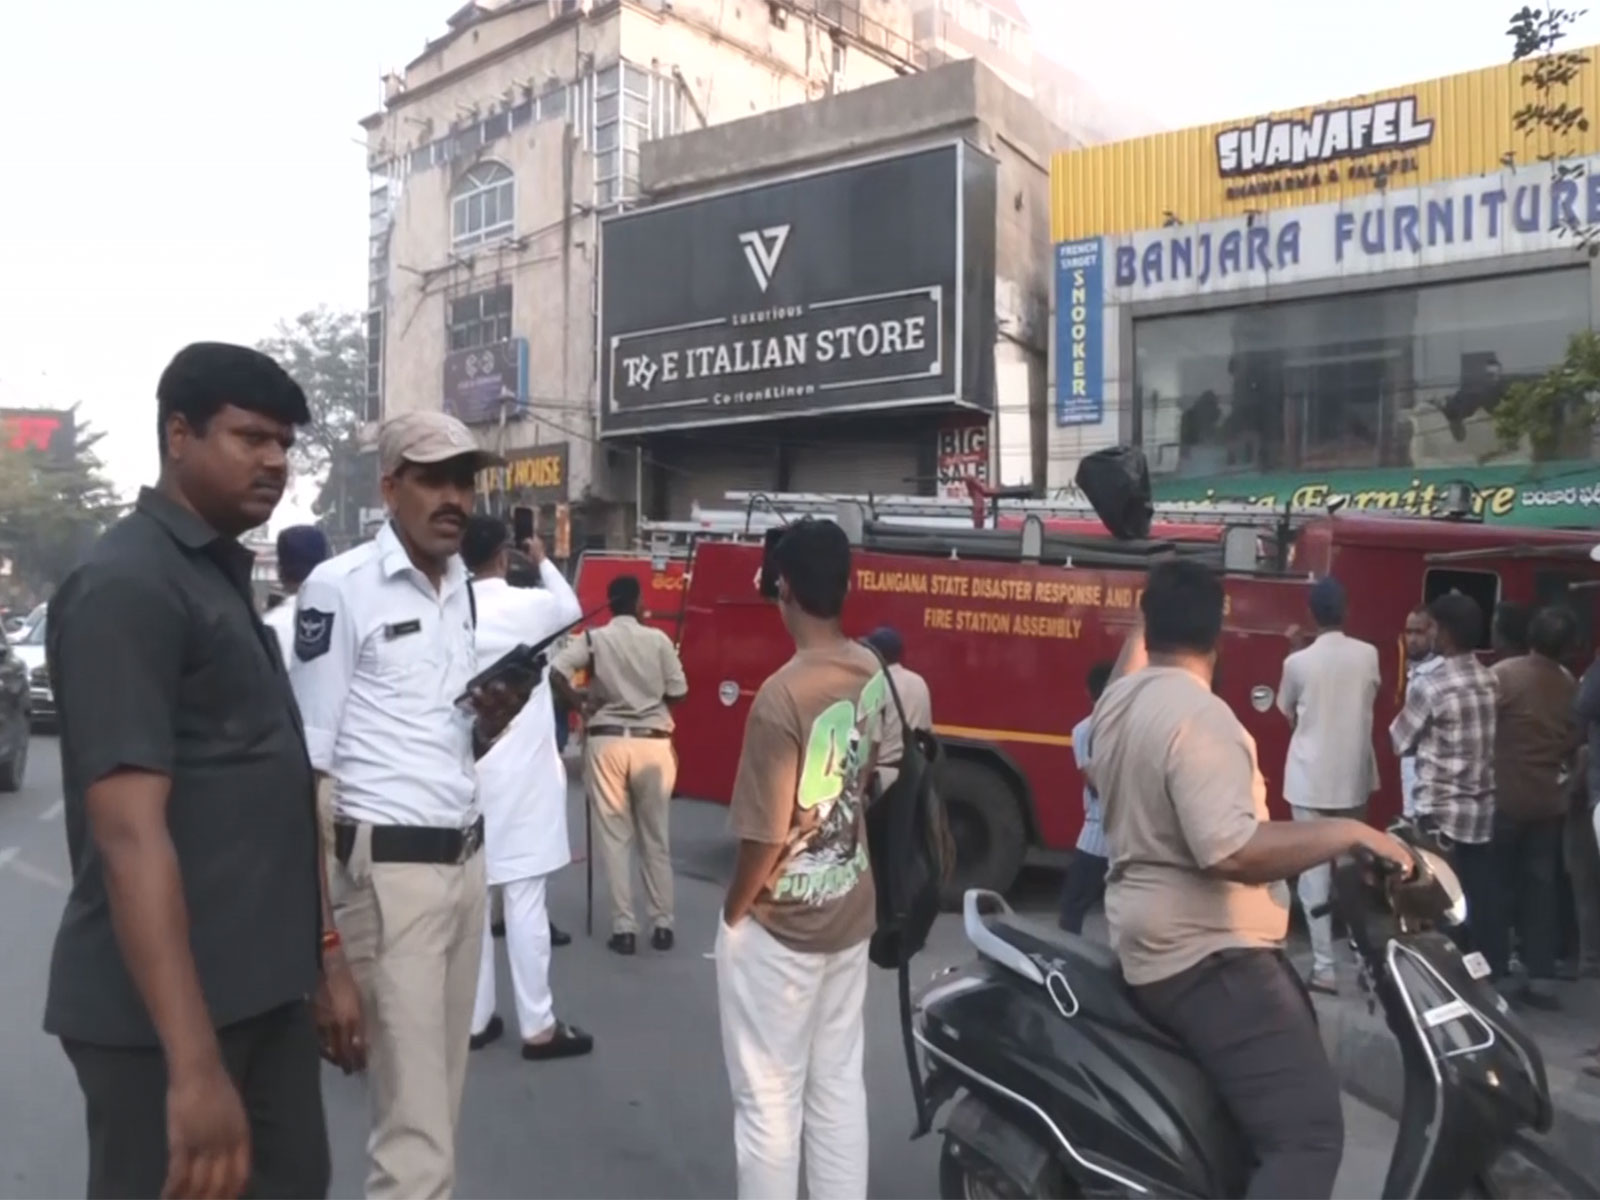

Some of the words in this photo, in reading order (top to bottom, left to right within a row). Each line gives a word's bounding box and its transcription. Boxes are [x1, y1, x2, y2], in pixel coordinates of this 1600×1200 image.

[1217, 97, 1433, 174] SHAWAFEL
[1226, 171, 1321, 199] SHAWARMA
[1348, 156, 1419, 180] FALAFEL
[1060, 241, 1099, 257] FRENCH
[1114, 220, 1301, 288] BANJARA
[1335, 172, 1600, 262] FURNITURE
[731, 304, 804, 327] Luxurious
[1071, 269, 1087, 396] SNOOKER
[622, 350, 679, 391] THE
[685, 333, 809, 379] ITALIAN
[816, 316, 926, 362] STORE
[941, 426, 987, 455] BIG
[515, 455, 562, 488] HOUSE
[940, 461, 987, 486] SALE
[1292, 478, 1516, 516] Frnitre
[856, 570, 928, 593] TELANGANA
[930, 575, 969, 597] STATE
[971, 577, 1032, 602] DISASTER
[1034, 581, 1101, 606] RESPONSE
[1105, 585, 1133, 609] AND
[924, 608, 953, 630] FIRE
[956, 611, 1011, 634] STATION
[1013, 615, 1082, 640] ASSEMBLY
